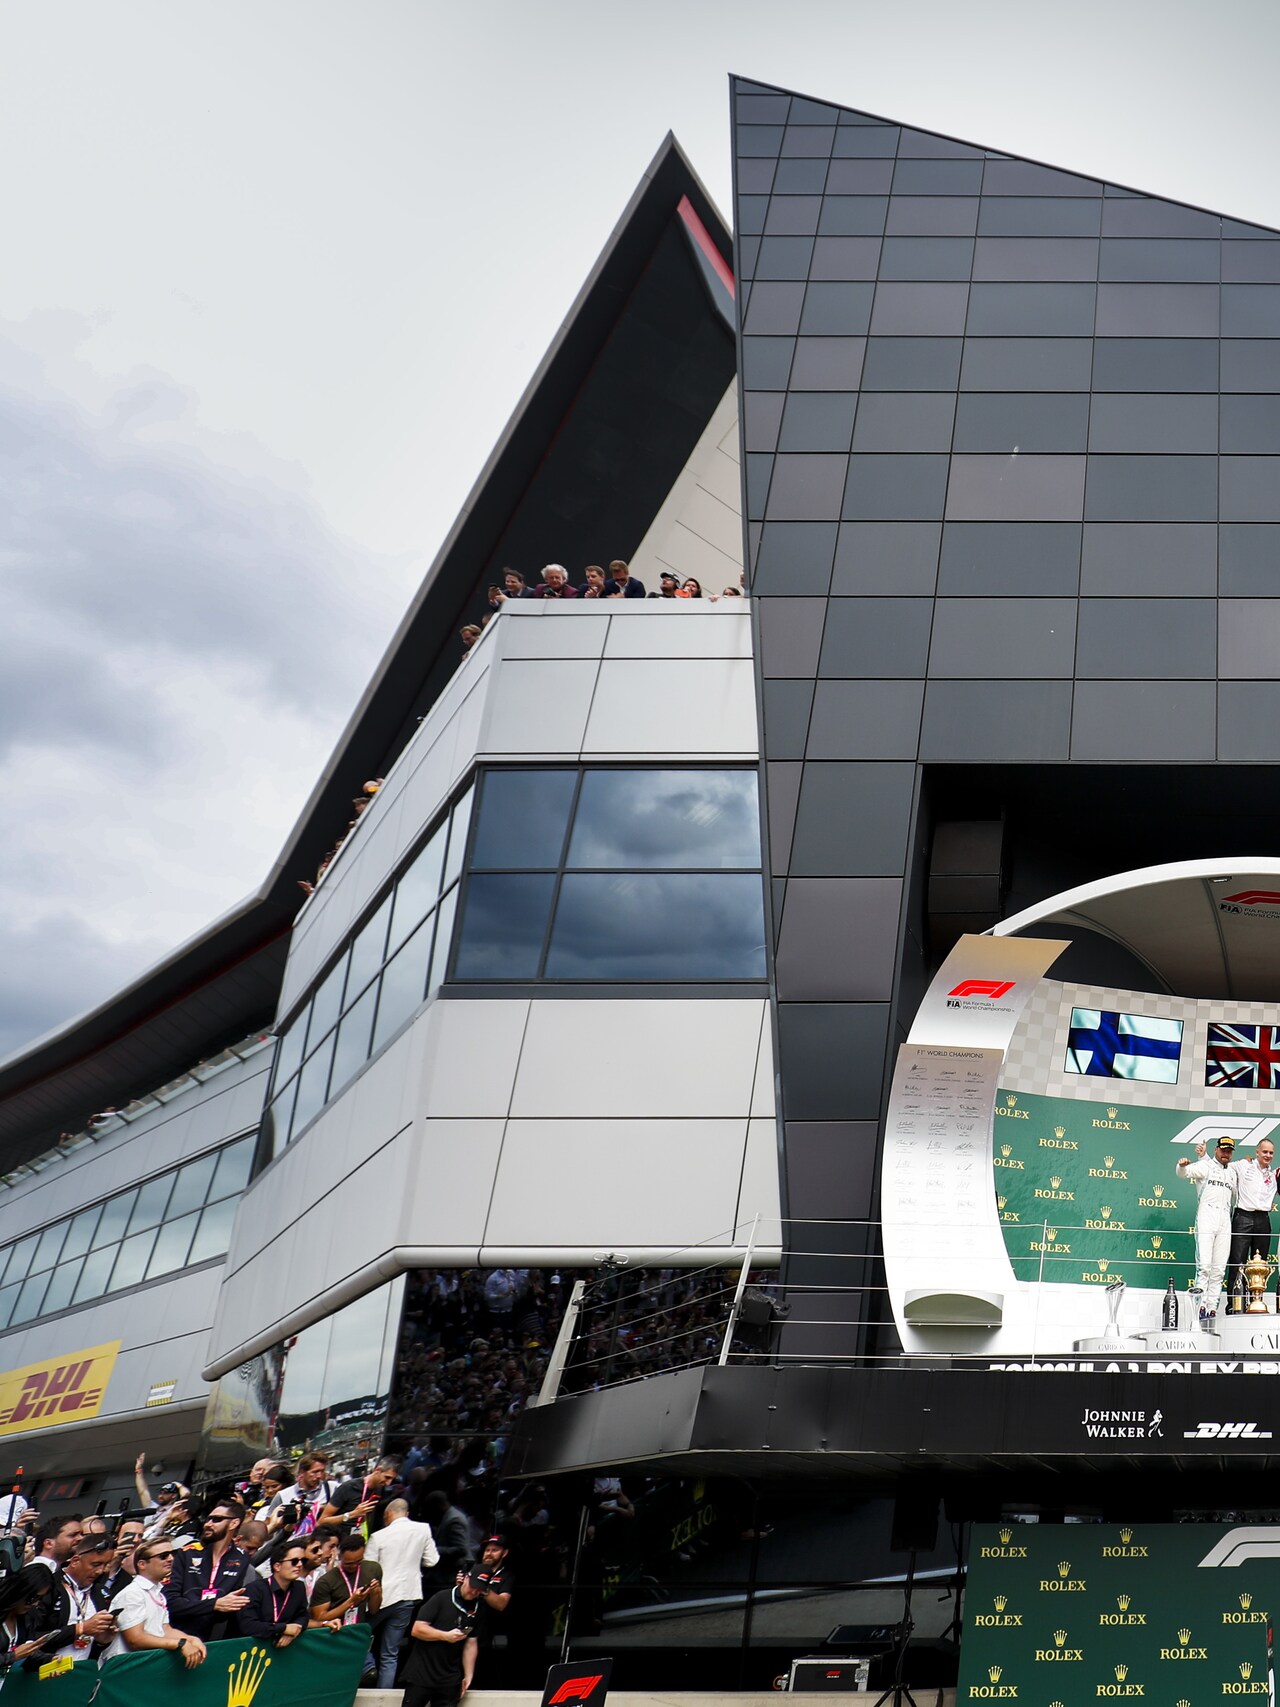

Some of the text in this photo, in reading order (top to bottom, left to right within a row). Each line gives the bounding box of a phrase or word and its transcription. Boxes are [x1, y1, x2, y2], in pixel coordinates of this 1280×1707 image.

[946, 1000, 961, 1008] FIA
[949, 1051, 983, 1059] CHAMPIONS
[1092, 1119, 1131, 1130] ROLEX
[1039, 1138, 1078, 1150] ROLEX
[994, 1158, 1024, 1170] OLEX
[1088, 1168, 1128, 1180] ROLEX
[1034, 1189, 1075, 1200] ROLEX
[1138, 1198, 1177, 1208] ROLEX
[999, 1212, 1020, 1222] LEX
[1085, 1220, 1126, 1230] ROLEX
[1030, 1242, 1071, 1253] ROLEX
[1136, 1250, 1176, 1260] ROLEX
[1082, 1272, 1123, 1283] ROLEX
[1169, 1300, 1177, 1328] CARBON
[1156, 1340, 1197, 1350] CARBON
[1082, 1408, 1146, 1424] JOHNNIE
[1086, 1425, 1145, 1438] WALKER
[1196, 1422, 1261, 1438] DHL
[981, 1547, 1028, 1558] ROLEX
[1102, 1546, 1148, 1557] ROLEX
[1040, 1580, 1086, 1592] ROLEX
[975, 1616, 1023, 1626] ROLEX
[1100, 1614, 1146, 1625] ROLEX
[1222, 1612, 1268, 1624] ROLEX
[1035, 1650, 1083, 1661] ROLEX
[1160, 1648, 1208, 1660] ROLEX
[548, 1674, 604, 1705] F1
[969, 1686, 1018, 1698] ROLEX
[1096, 1684, 1144, 1696] ROLEX
[1222, 1682, 1268, 1694] ROLEX
